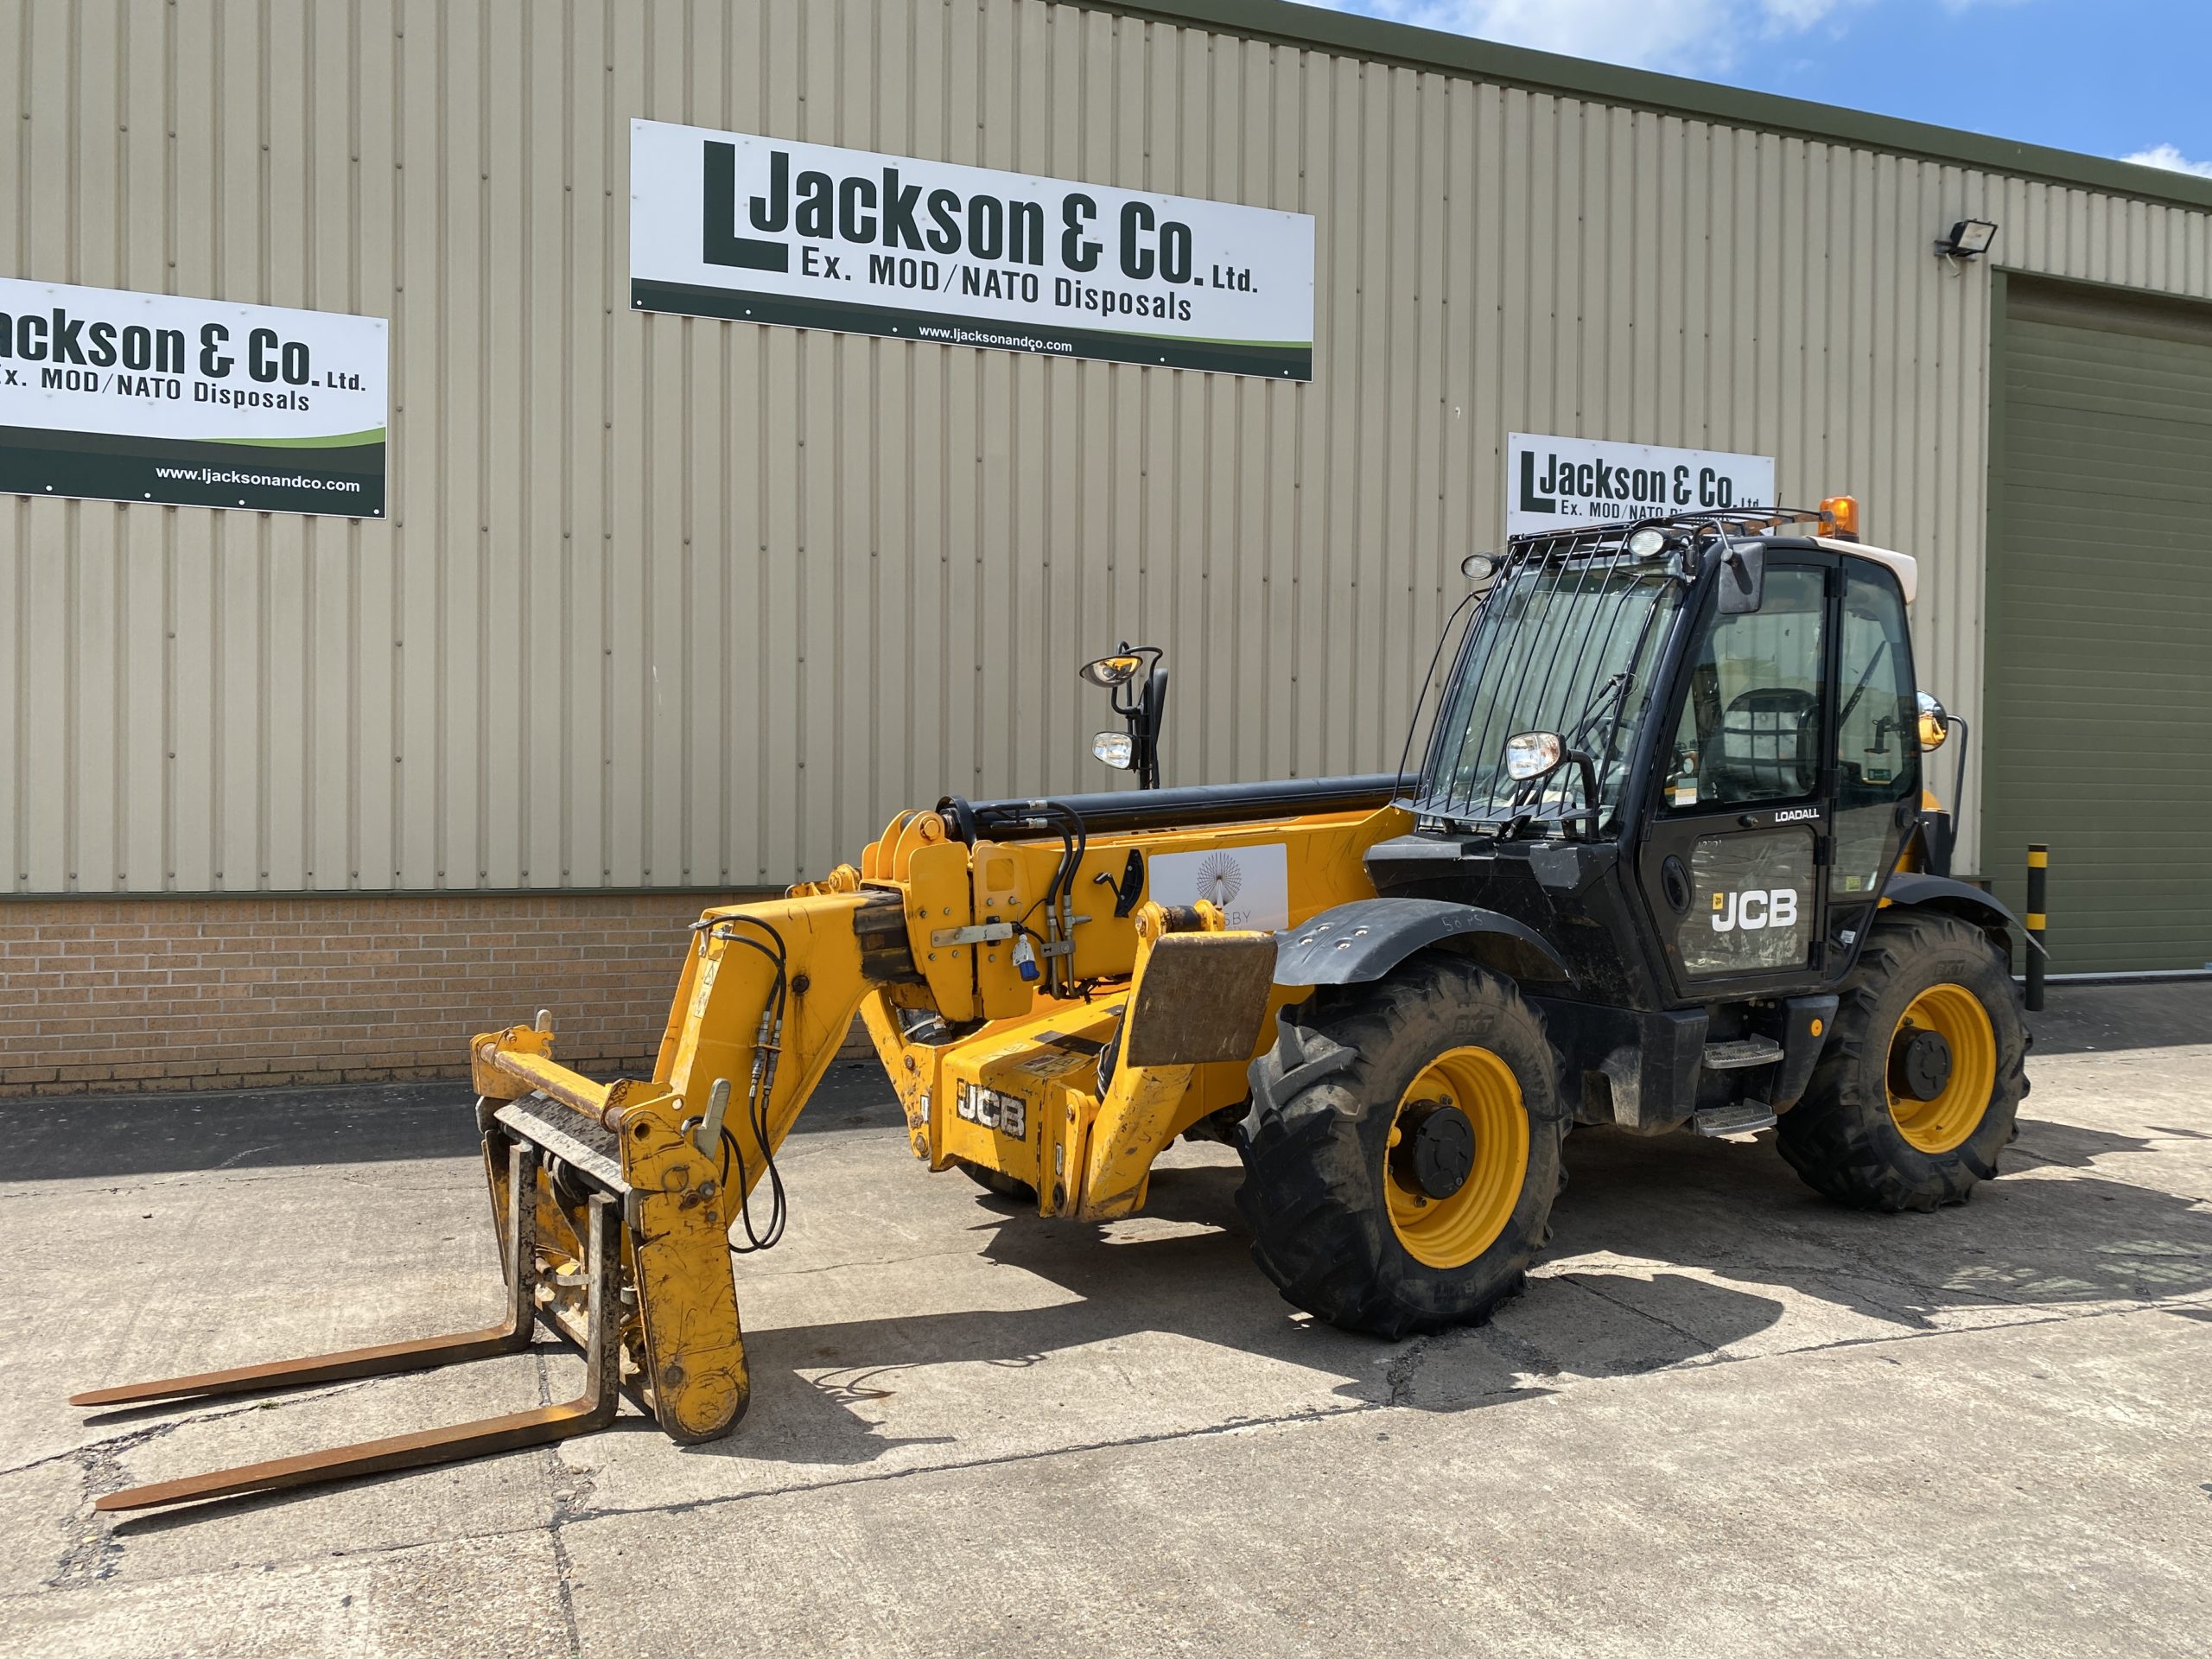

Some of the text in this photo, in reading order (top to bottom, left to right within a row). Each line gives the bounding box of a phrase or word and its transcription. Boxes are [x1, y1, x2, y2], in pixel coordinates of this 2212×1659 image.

[1061, 193, 1103, 273] &
[1120, 200, 1204, 287] Co.
[1212, 264, 1258, 294] Ltd.
[802, 245, 1192, 321] Ex. MOD/NATO Disposals
[200, 322, 235, 378] &
[249, 327, 320, 387] Co.
[327, 371, 366, 391] Ltd.
[918, 325, 1072, 353] www.ljacksonandco.com
[0, 364, 309, 411] x. MOD/NATO Disposals
[156, 466, 361, 493] www.ljacksonandco.com
[1673, 465, 1693, 505] &
[1699, 467, 1738, 508] Co.
[1561, 499, 1583, 516] Ex.
[1590, 502, 1663, 519] MOD/NATO
[1776, 808, 1820, 822] LOADALL
[1712, 888, 1798, 932] JCB
[1455, 1018, 1493, 1034] BKT
[957, 1084, 1025, 1137] JCB
